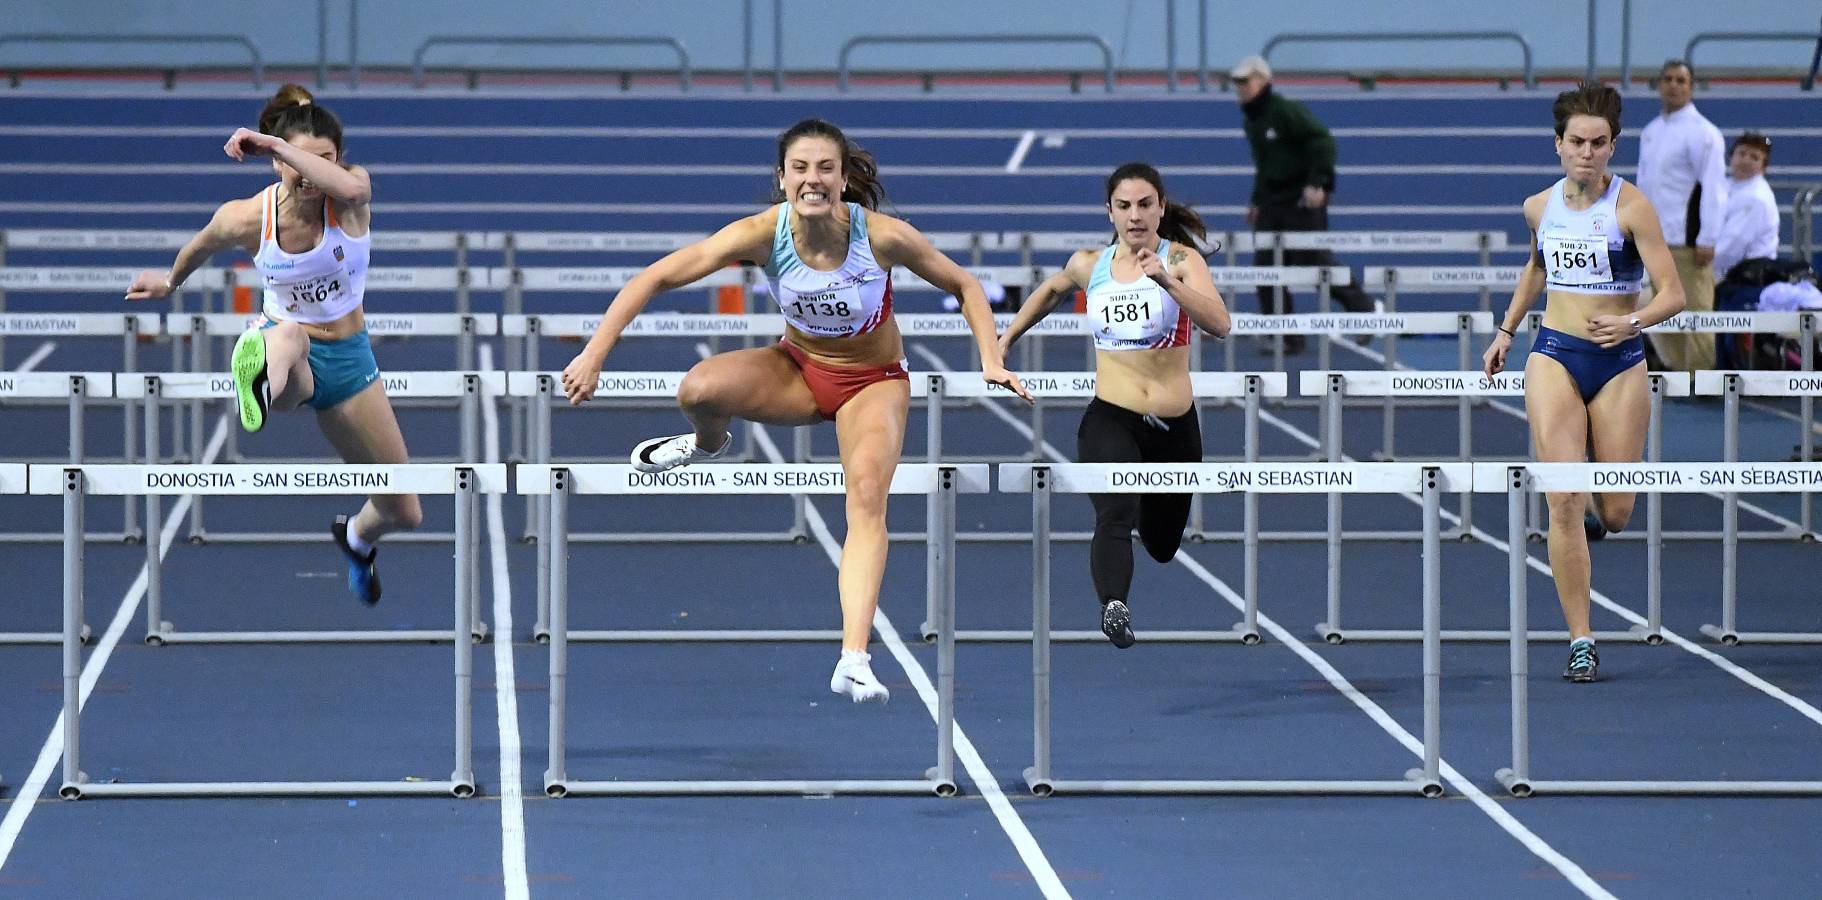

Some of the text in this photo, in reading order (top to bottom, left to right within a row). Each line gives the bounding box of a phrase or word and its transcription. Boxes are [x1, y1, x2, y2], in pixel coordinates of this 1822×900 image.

[1559, 242, 1588, 250] SUB-23
[1551, 250, 1598, 269] 1561
[797, 293, 836, 302] SENIOR
[1109, 293, 1140, 302] SUB-23
[792, 301, 851, 317] 1138
[1101, 301, 1150, 324] 1581
[11, 319, 77, 330] SEBASTIAN
[655, 320, 679, 331] SAN
[683, 320, 749, 331] SEBASTIAN
[1237, 318, 1298, 329] DONOSTIA
[1310, 318, 1335, 329] SAN
[1339, 318, 1404, 329] SEBASTIAN
[596, 378, 667, 391] DONOSTIA
[1392, 377, 1465, 391] DONOSTIA
[1479, 377, 1507, 391] SAN
[147, 473, 235, 487] DONOSTIA
[253, 473, 288, 487] SAN
[294, 473, 388, 487] SEBASTIAN
[628, 471, 715, 487] DONOSTIA
[733, 472, 768, 486] SAN
[774, 472, 844, 486] SEBASTI
[1112, 471, 1200, 486] DONOSTIA
[1217, 471, 1251, 486] SAN
[1258, 471, 1352, 486] SEBASTIAN
[1594, 471, 1682, 486] DONOSTIA
[1700, 471, 1735, 485] SAN
[1741, 470, 1822, 485] SEBASTIA
